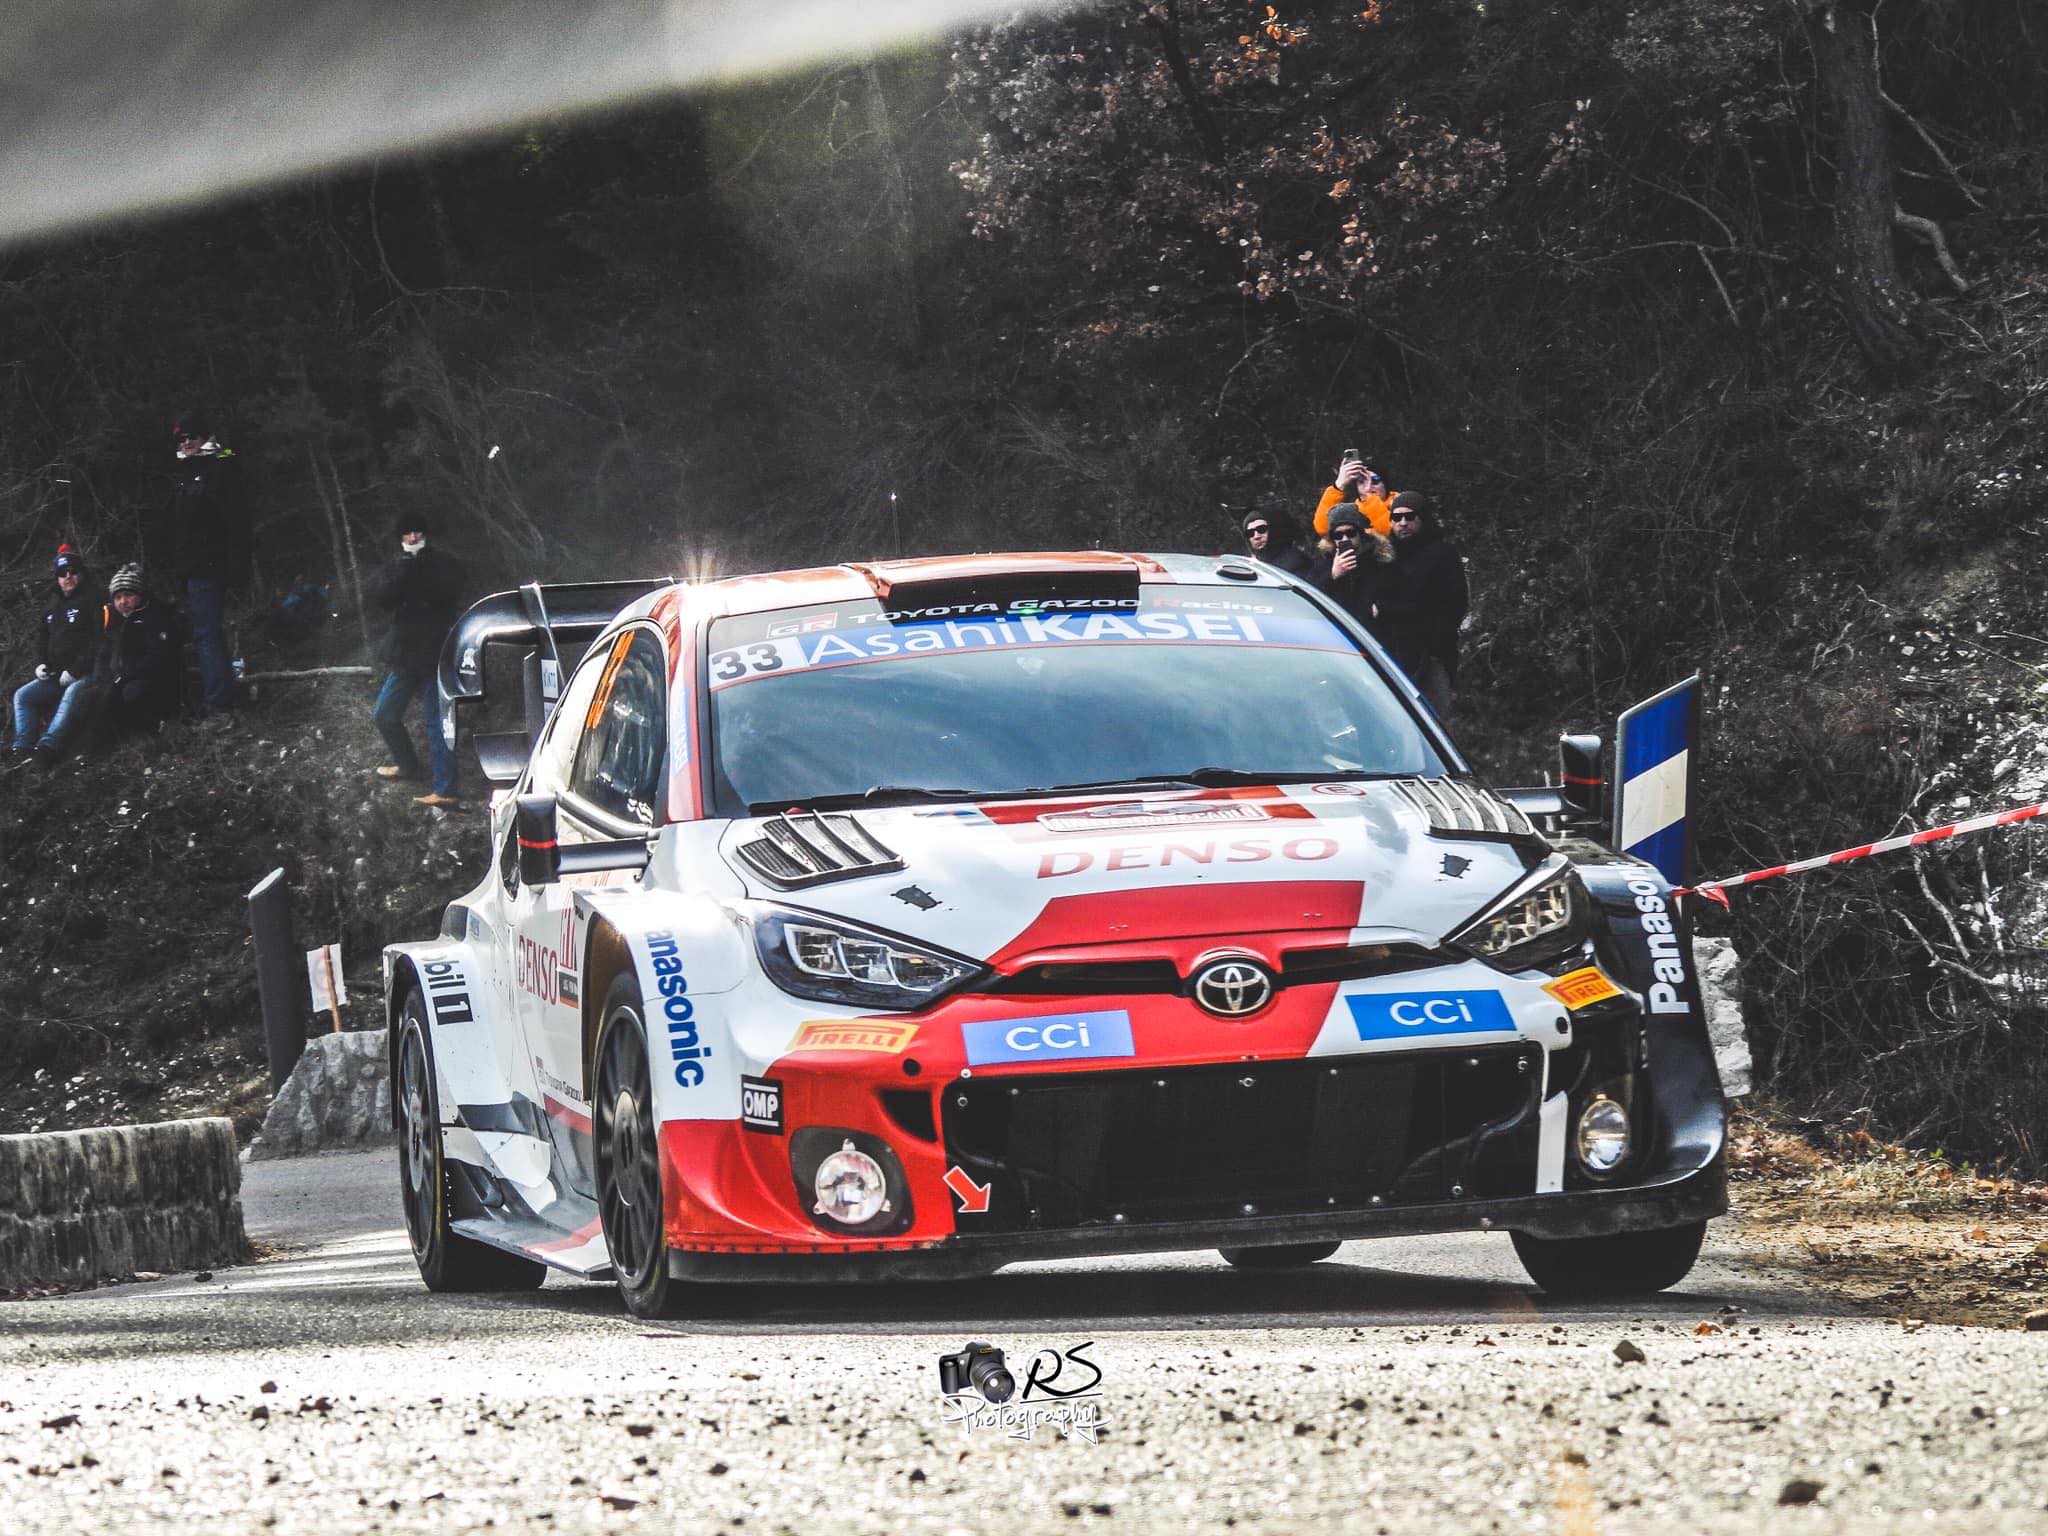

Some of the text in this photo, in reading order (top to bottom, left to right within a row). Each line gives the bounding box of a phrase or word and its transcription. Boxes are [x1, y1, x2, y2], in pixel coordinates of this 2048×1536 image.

[769, 620, 835, 637] GR
[848, 599, 1274, 624] TOYOTA GAZOO Racing
[711, 643, 783, 681] 33
[1037, 838, 1340, 879] DENSO
[518, 935, 558, 1006] DENSO
[645, 929, 712, 1088] anasonic
[796, 1023, 906, 1048] PIRELLI
[743, 1090, 779, 1120] OMP
